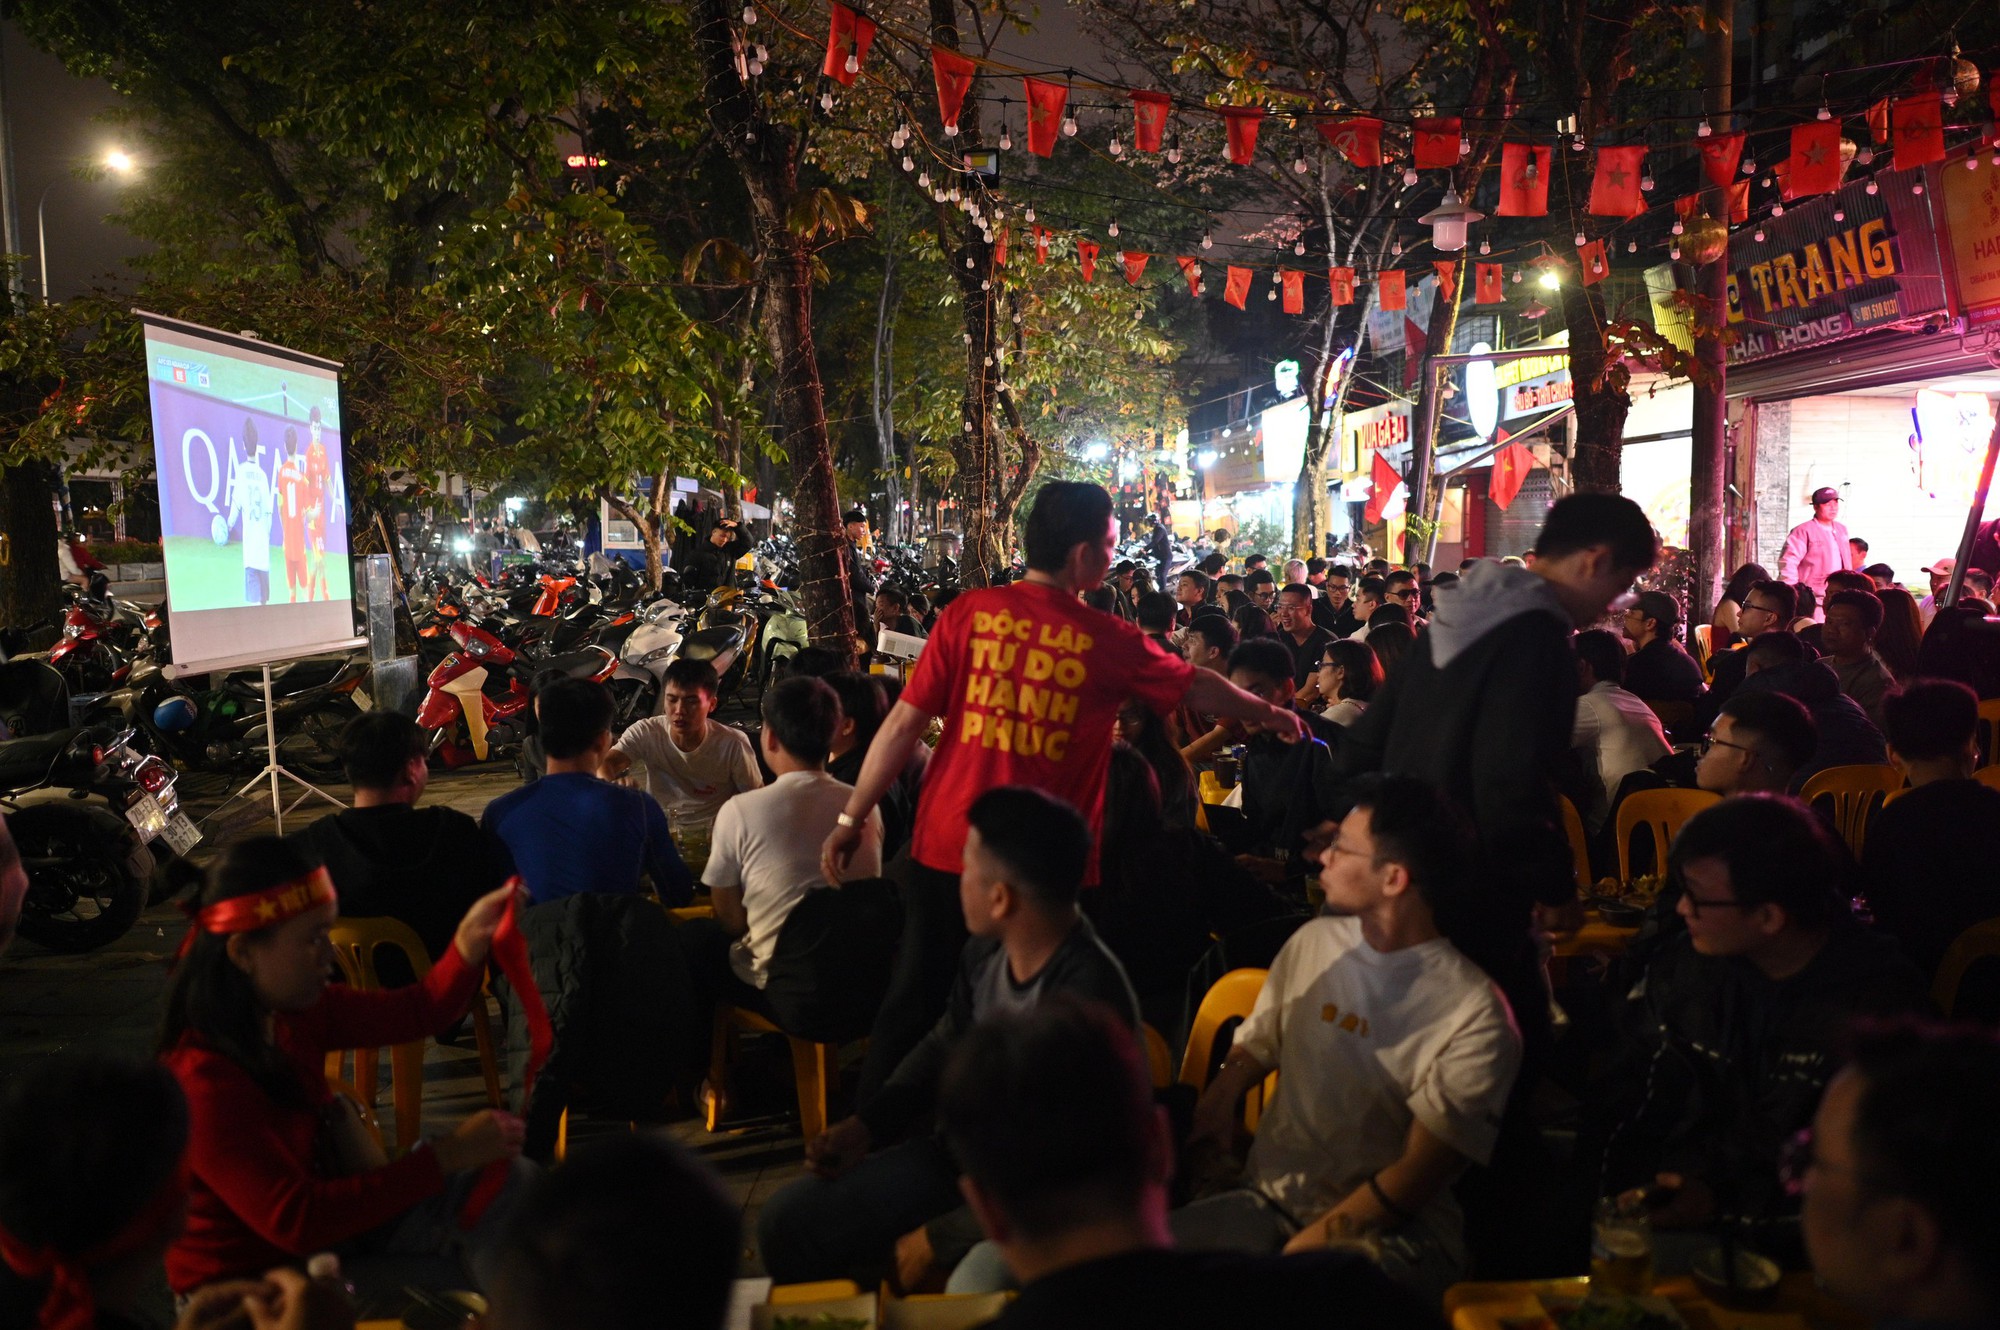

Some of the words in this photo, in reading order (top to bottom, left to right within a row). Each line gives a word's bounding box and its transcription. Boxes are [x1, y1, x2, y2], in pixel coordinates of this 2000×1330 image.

[1750, 218, 1895, 313] TRANG
[973, 608, 1033, 641] ĐỘC
[1038, 624, 1094, 654] LẬP
[969, 637, 1021, 678] TỰ
[1023, 648, 1086, 689] DO
[965, 673, 1079, 724] HẠNH
[960, 711, 1070, 762] PHÚC
